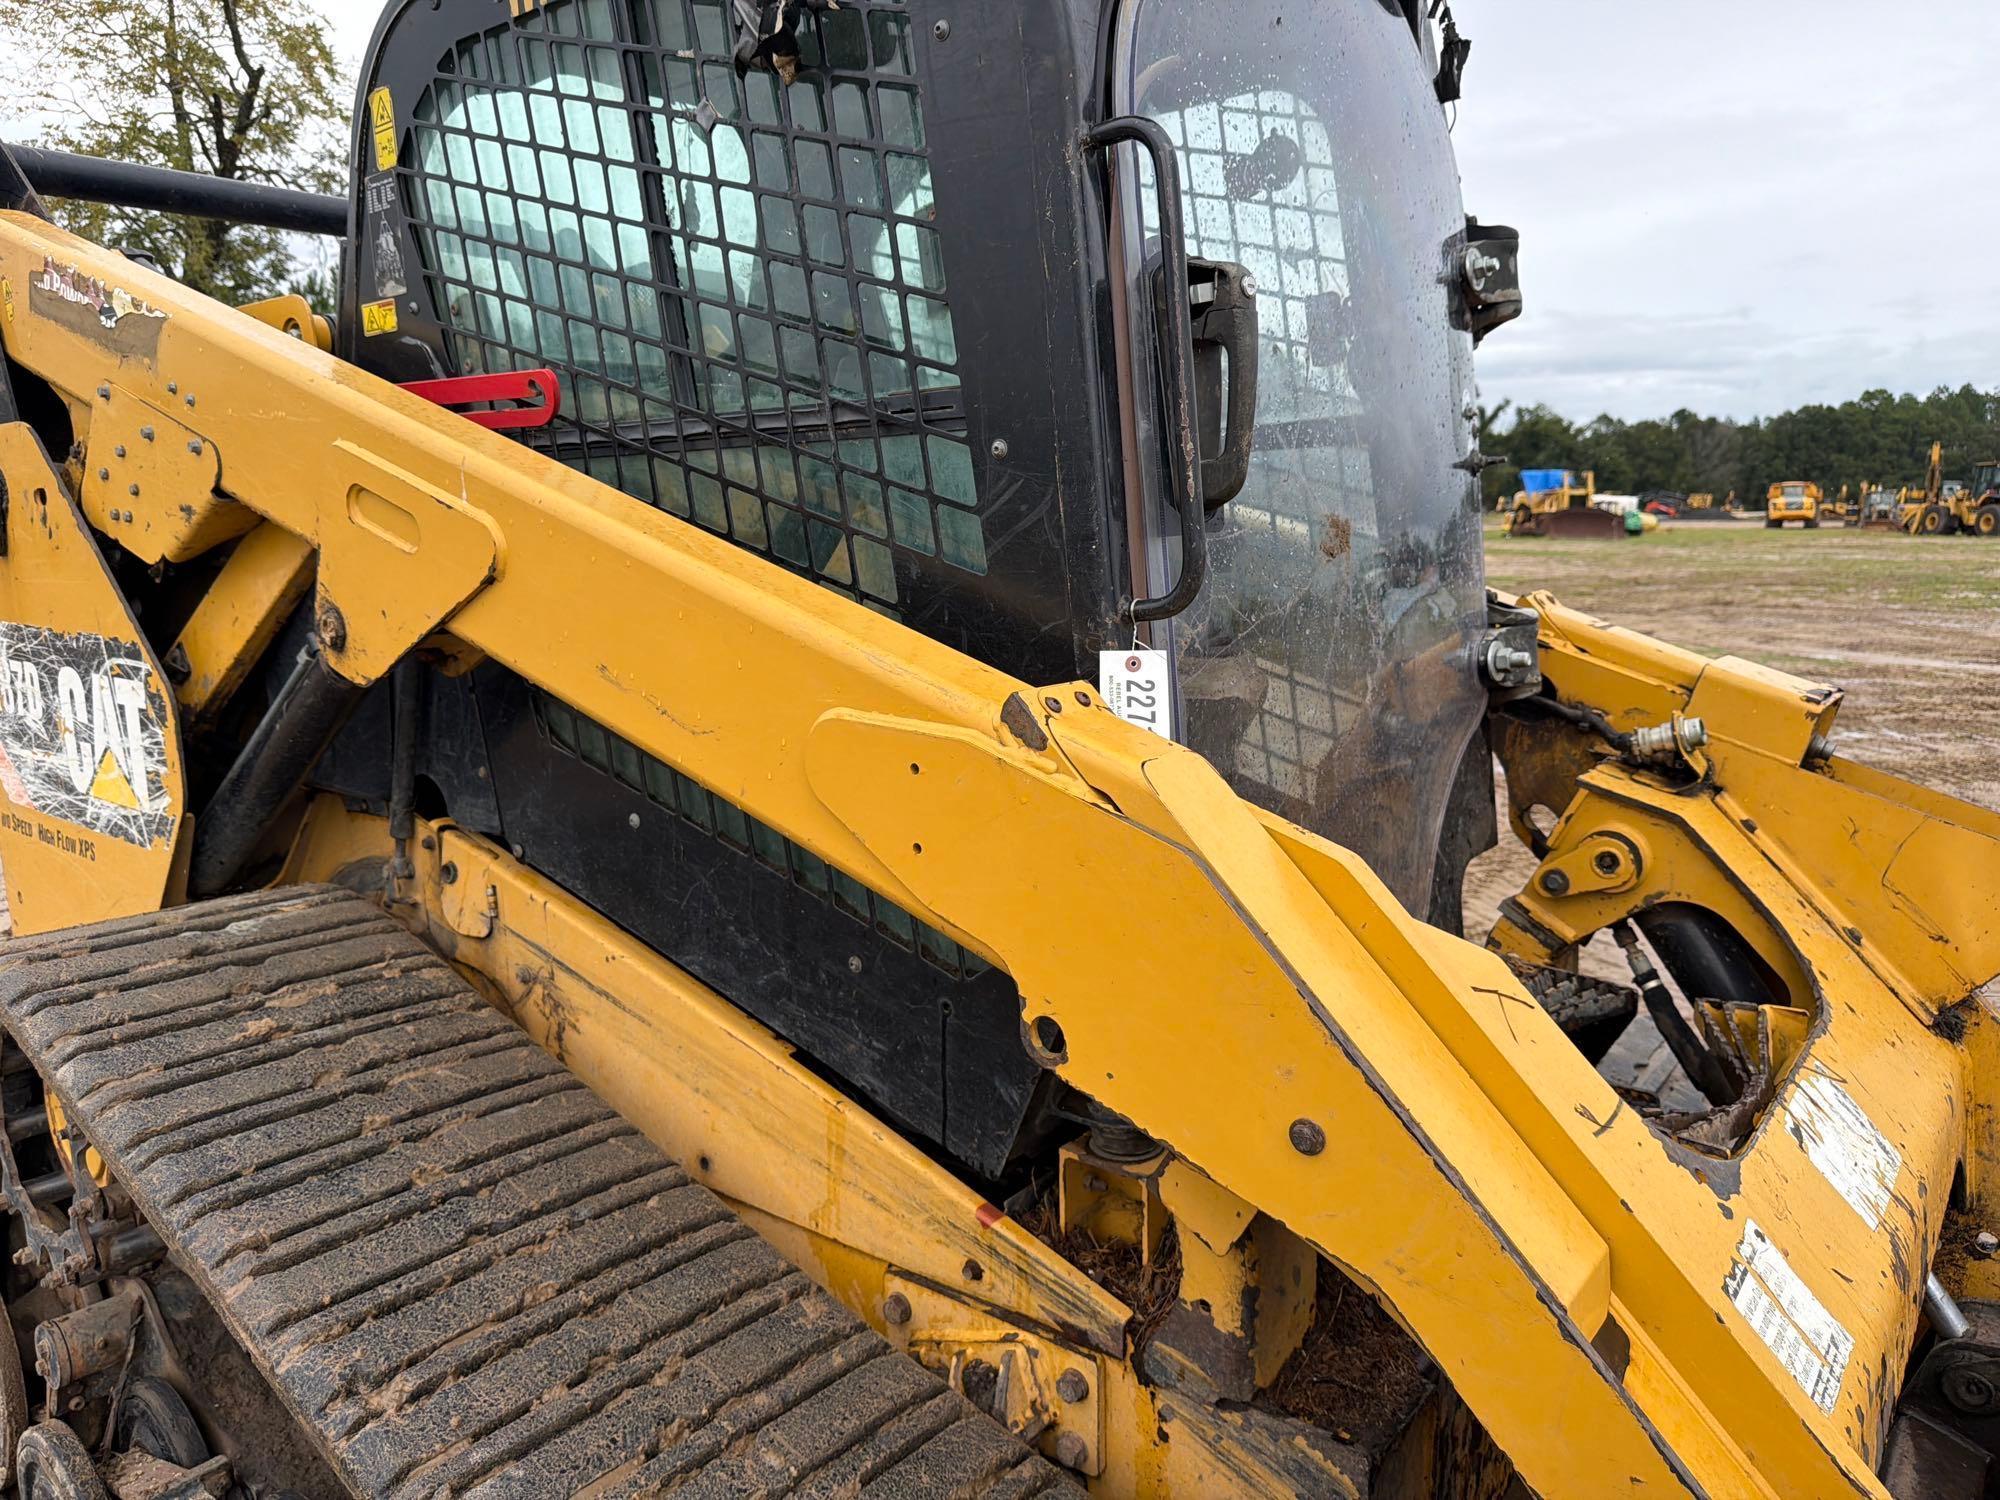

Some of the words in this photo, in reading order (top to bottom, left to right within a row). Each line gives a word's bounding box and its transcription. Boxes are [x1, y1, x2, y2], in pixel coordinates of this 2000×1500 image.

[1126, 680, 1156, 731] 227
[58, 666, 151, 811] CAT
[78, 838, 96, 862] XPS
